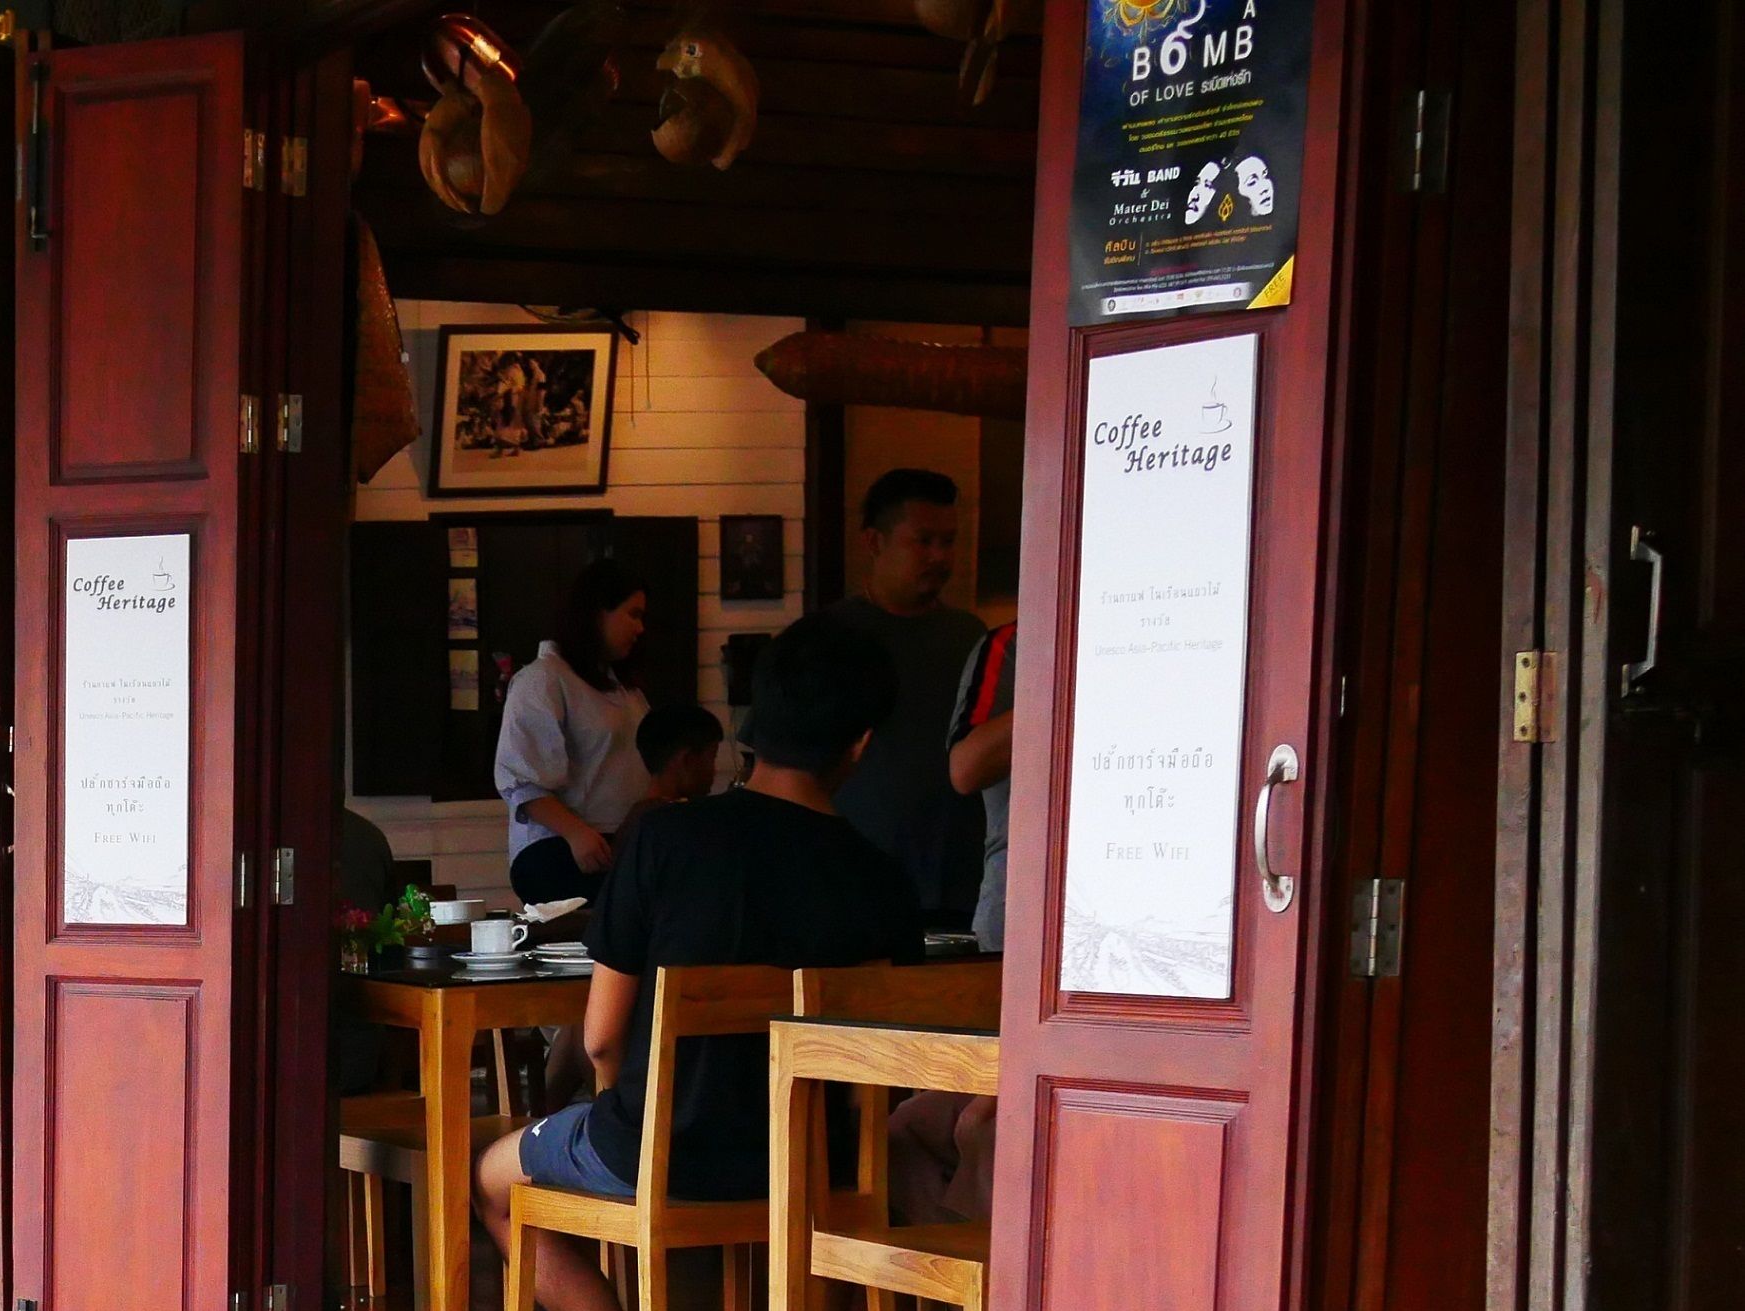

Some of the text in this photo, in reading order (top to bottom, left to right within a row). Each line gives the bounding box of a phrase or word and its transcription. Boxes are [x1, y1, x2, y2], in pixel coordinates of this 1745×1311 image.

[1129, 89, 1150, 107] OF
[1155, 81, 1194, 102] LOVE
[1147, 166, 1181, 183] BAND
[1140, 188, 1150, 199] &
[1113, 198, 1170, 216] Mater Dei
[1109, 212, 1172, 226] Orchestra
[1093, 413, 1162, 451] Coffee
[1123, 443, 1232, 473] Heritage
[73, 574, 124, 597] Coffee
[96, 594, 176, 613] Heritage
